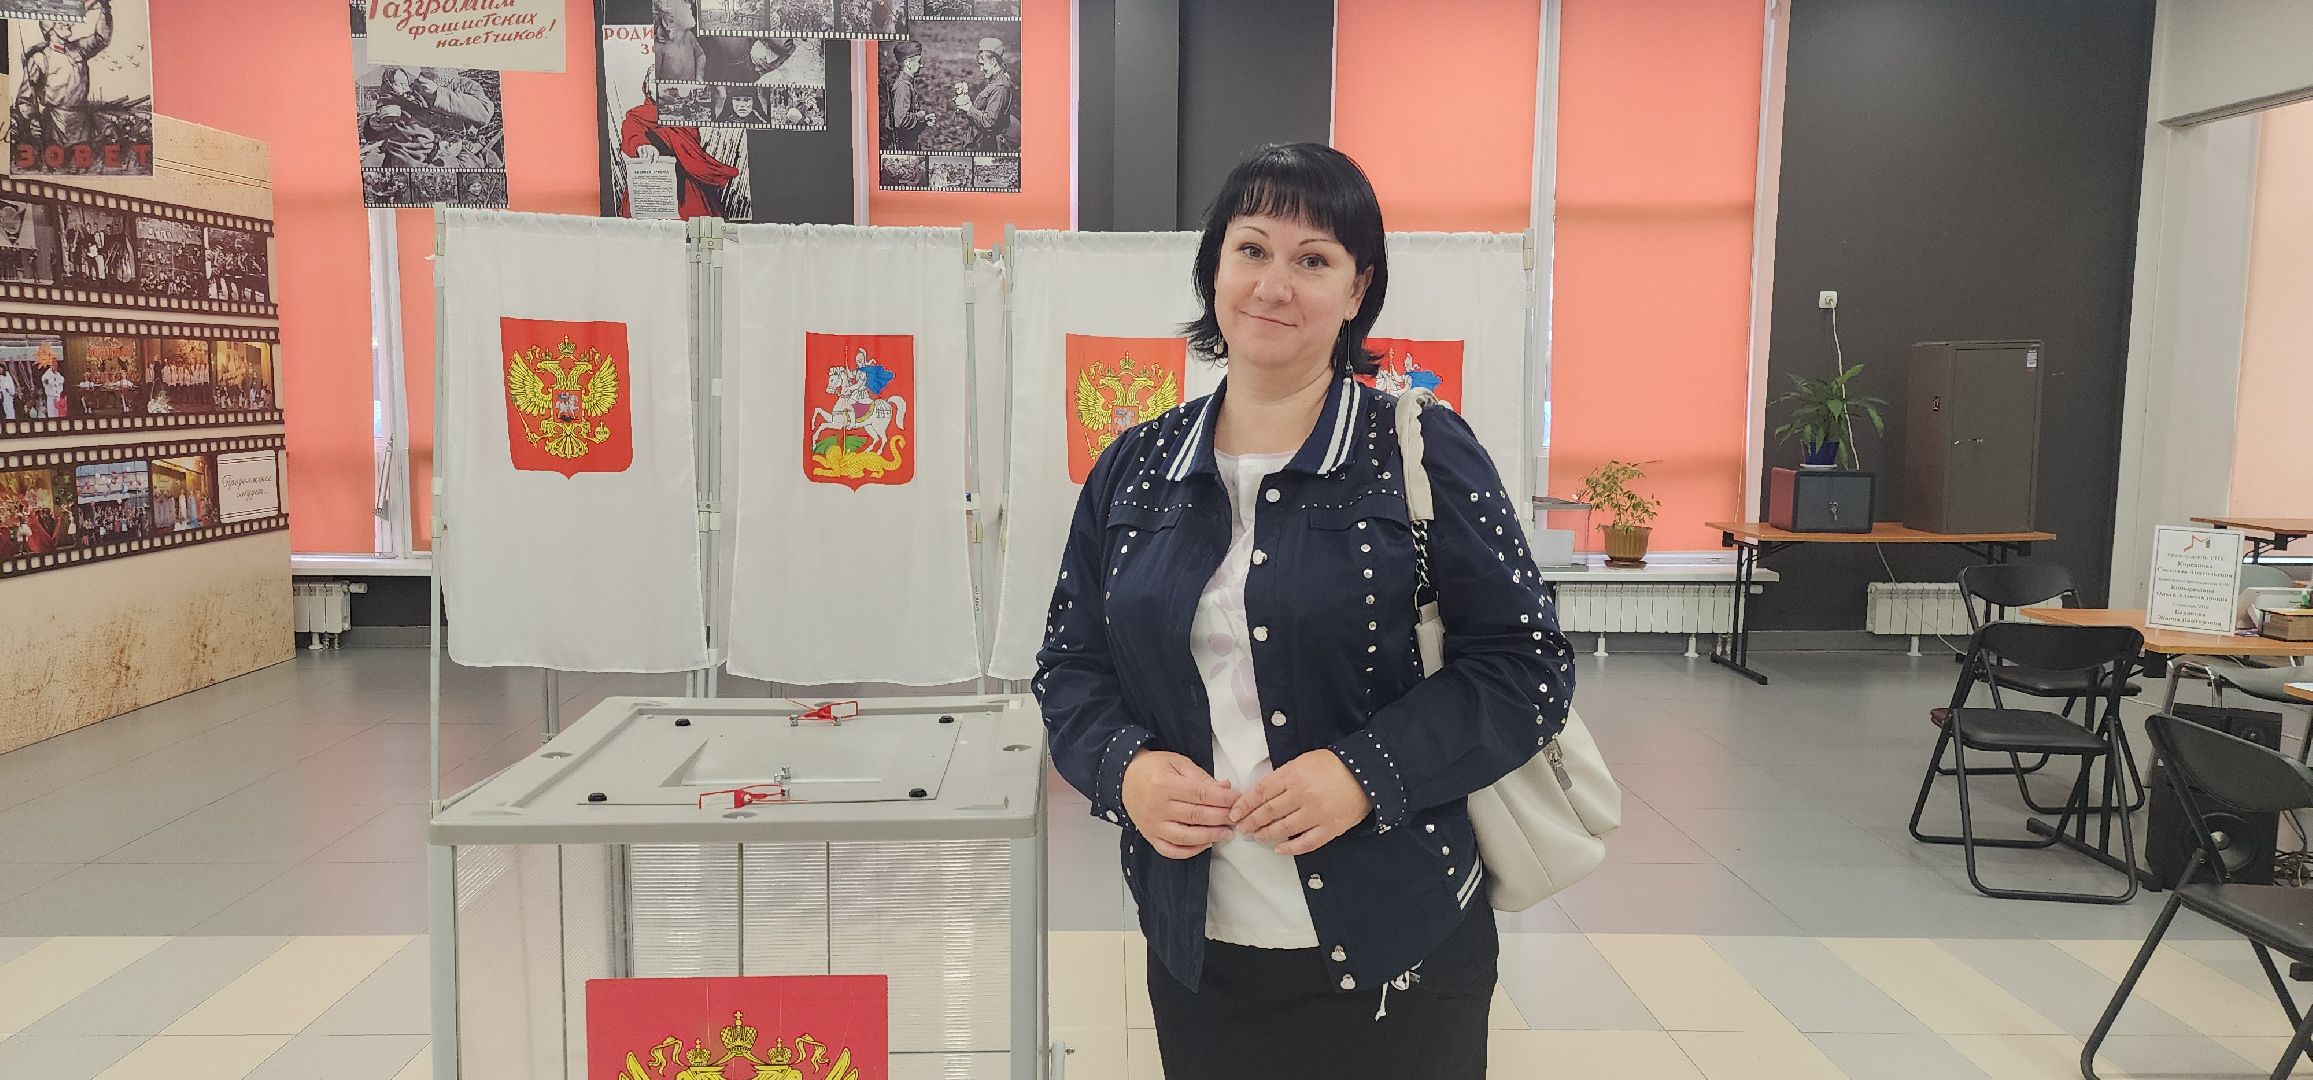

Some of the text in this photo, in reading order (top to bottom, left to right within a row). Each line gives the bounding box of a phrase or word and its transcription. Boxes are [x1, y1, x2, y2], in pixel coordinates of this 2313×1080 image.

[409, 13, 537, 40] фашистских
[436, 19, 556, 48] налетчиков!
[16, 144, 151, 168] ЗОВЕТ
